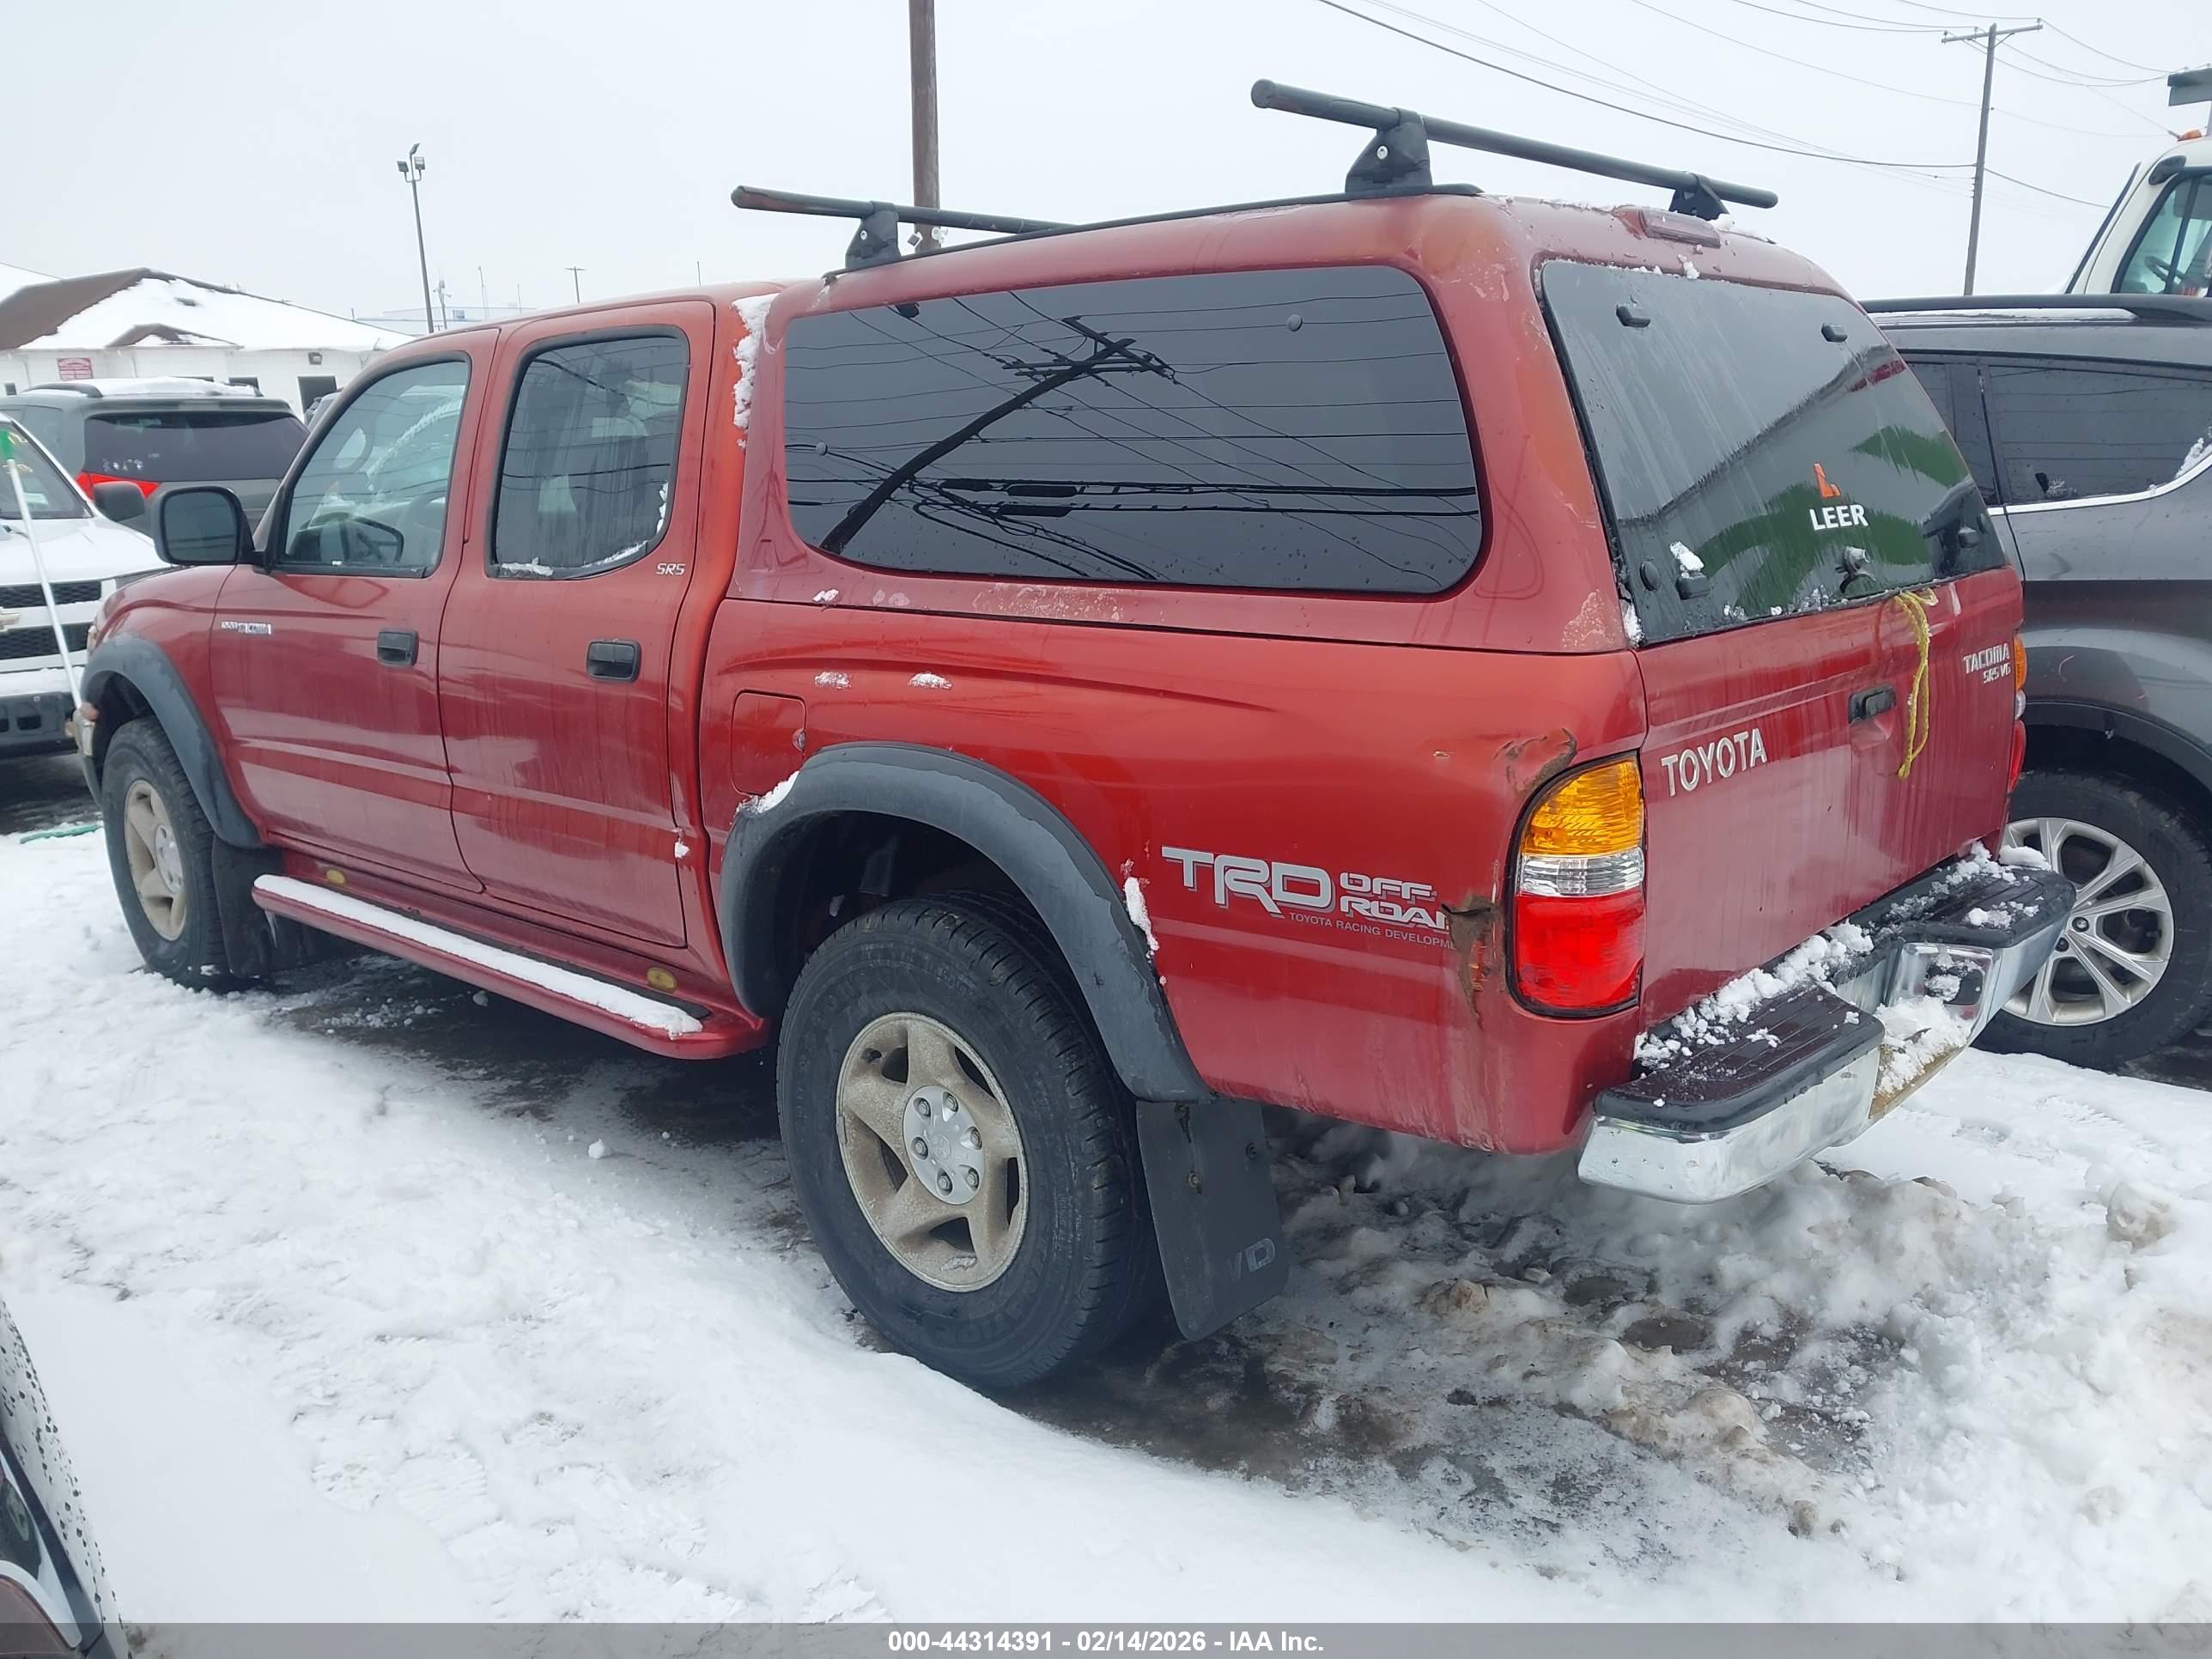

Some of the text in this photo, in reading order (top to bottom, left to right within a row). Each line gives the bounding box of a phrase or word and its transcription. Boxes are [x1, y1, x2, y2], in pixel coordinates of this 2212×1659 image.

[1809, 504, 1869, 531] LEER
[655, 562, 686, 576] SR5
[1963, 642, 2010, 674] TACOMA
[1661, 727, 1767, 798] TOYOTA
[1161, 845, 1335, 917] TRD
[1340, 872, 1434, 902] OFF
[1289, 912, 1333, 927] TOYOTA
[1336, 920, 1381, 936] RACING
